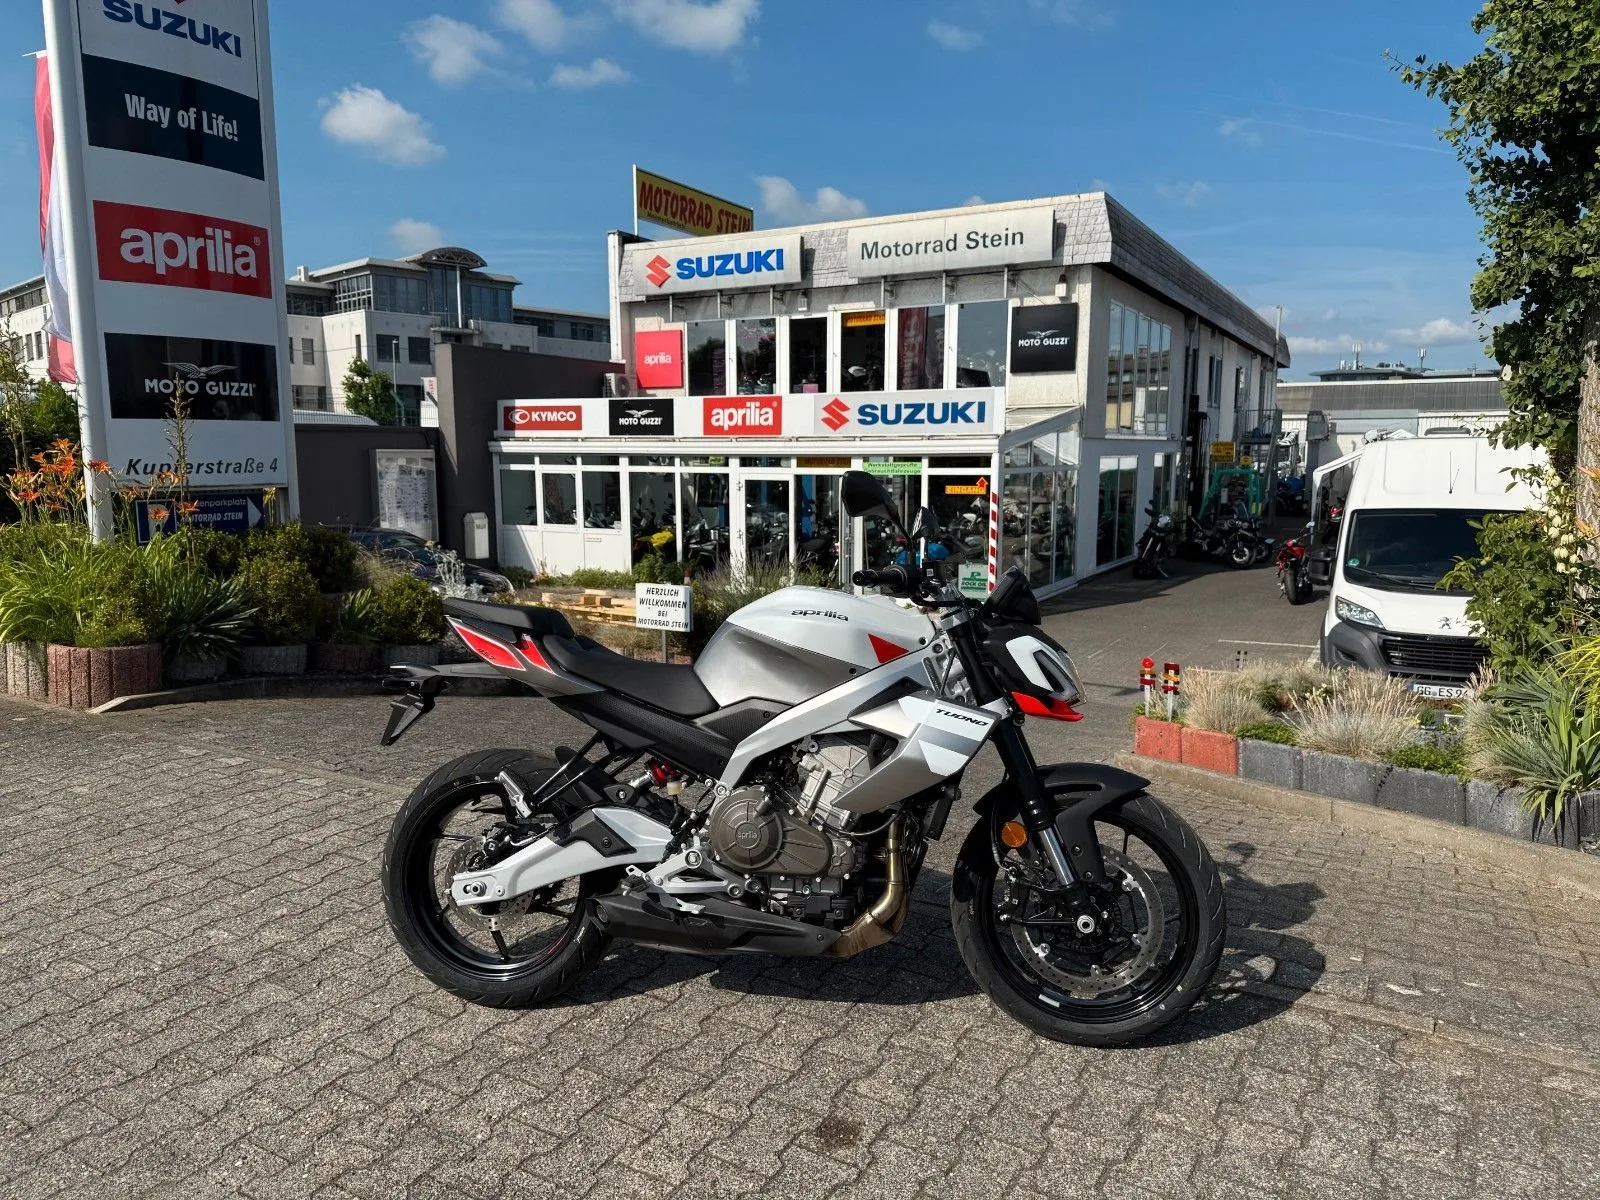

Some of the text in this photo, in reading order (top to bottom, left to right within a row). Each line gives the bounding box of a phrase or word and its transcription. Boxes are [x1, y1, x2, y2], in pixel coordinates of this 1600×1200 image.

[102, 0, 242, 58] SUZUKI
[125, 93, 238, 141] Way of Life!
[639, 181, 713, 230] MOTORRAD
[716, 208, 752, 234] STEIN
[860, 227, 1025, 261] Motorrad Stein
[120, 227, 257, 278] aprilia
[676, 248, 784, 280] SUZUKI
[1018, 337, 1068, 347] MOTO GUZZI
[643, 352, 672, 366] aprilia
[205, 381, 254, 397] GUZZI
[531, 410, 577, 422] KYMCO
[619, 417, 661, 425] MOTO GUZZI
[711, 401, 774, 430] aprilia
[857, 401, 986, 426] SUZUKI
[269, 457, 278, 473] 4
[223, 511, 244, 521] STEIN
[646, 586, 679, 597] HERZLICH
[639, 597, 688, 609] WILLKOMMEN
[657, 610, 668, 618] BEI
[791, 608, 849, 622] aprilia
[638, 617, 689, 629] MOTORRAD STEIN
[1417, 686, 1431, 696] GG
[1438, 687, 1453, 698] ES
[936, 708, 989, 726] TUONO
